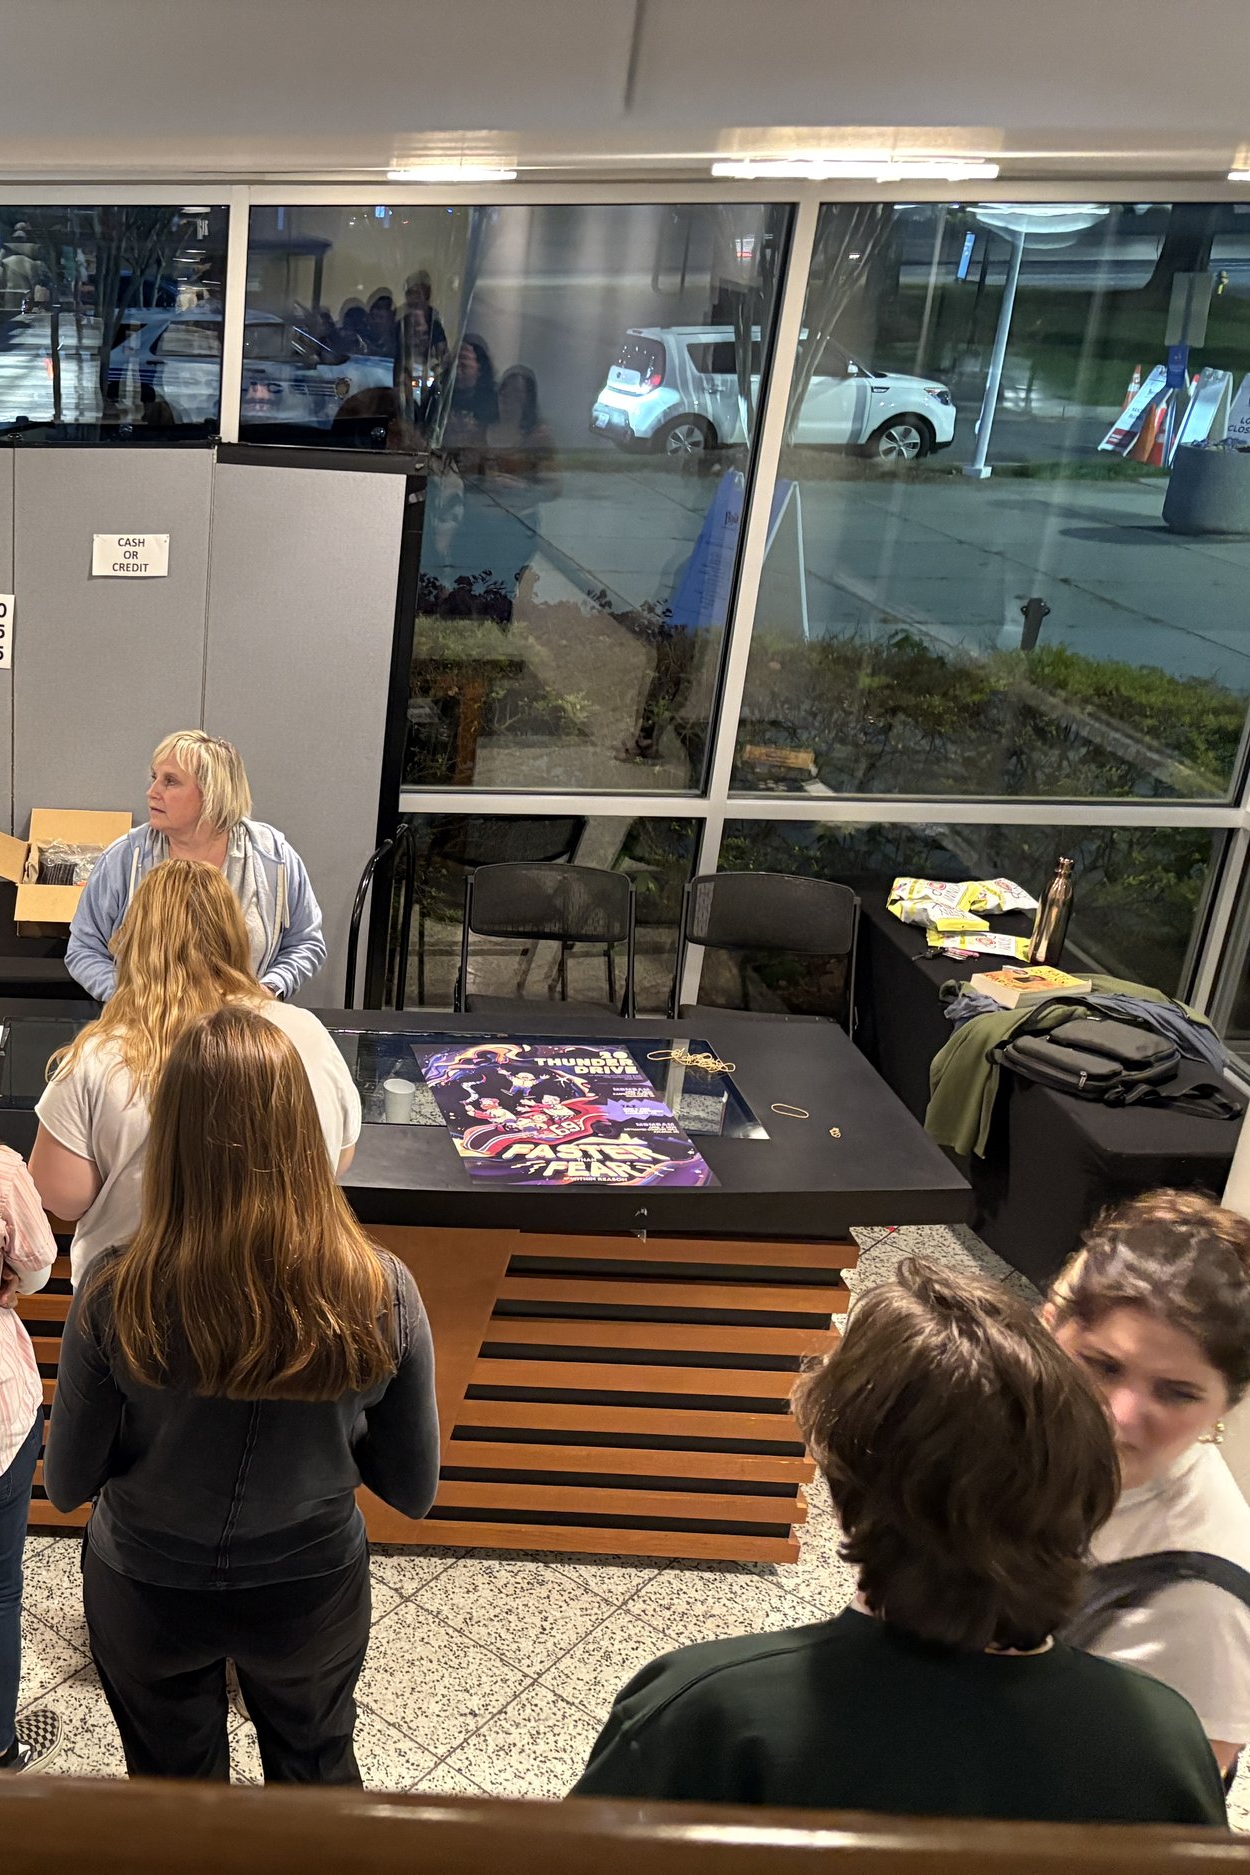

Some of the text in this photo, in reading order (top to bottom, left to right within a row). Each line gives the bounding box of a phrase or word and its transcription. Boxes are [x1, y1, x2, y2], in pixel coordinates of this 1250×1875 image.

[117, 537, 146, 548] CASH
[123, 550, 139, 560] OR
[112, 562, 149, 573] CREDIT
[599, 1051, 628, 1059] 20
[533, 1058, 634, 1066] THUNDER
[574, 1066, 639, 1074] DRIVE
[550, 1121, 581, 1136] 69
[502, 1144, 671, 1161] FASTER
